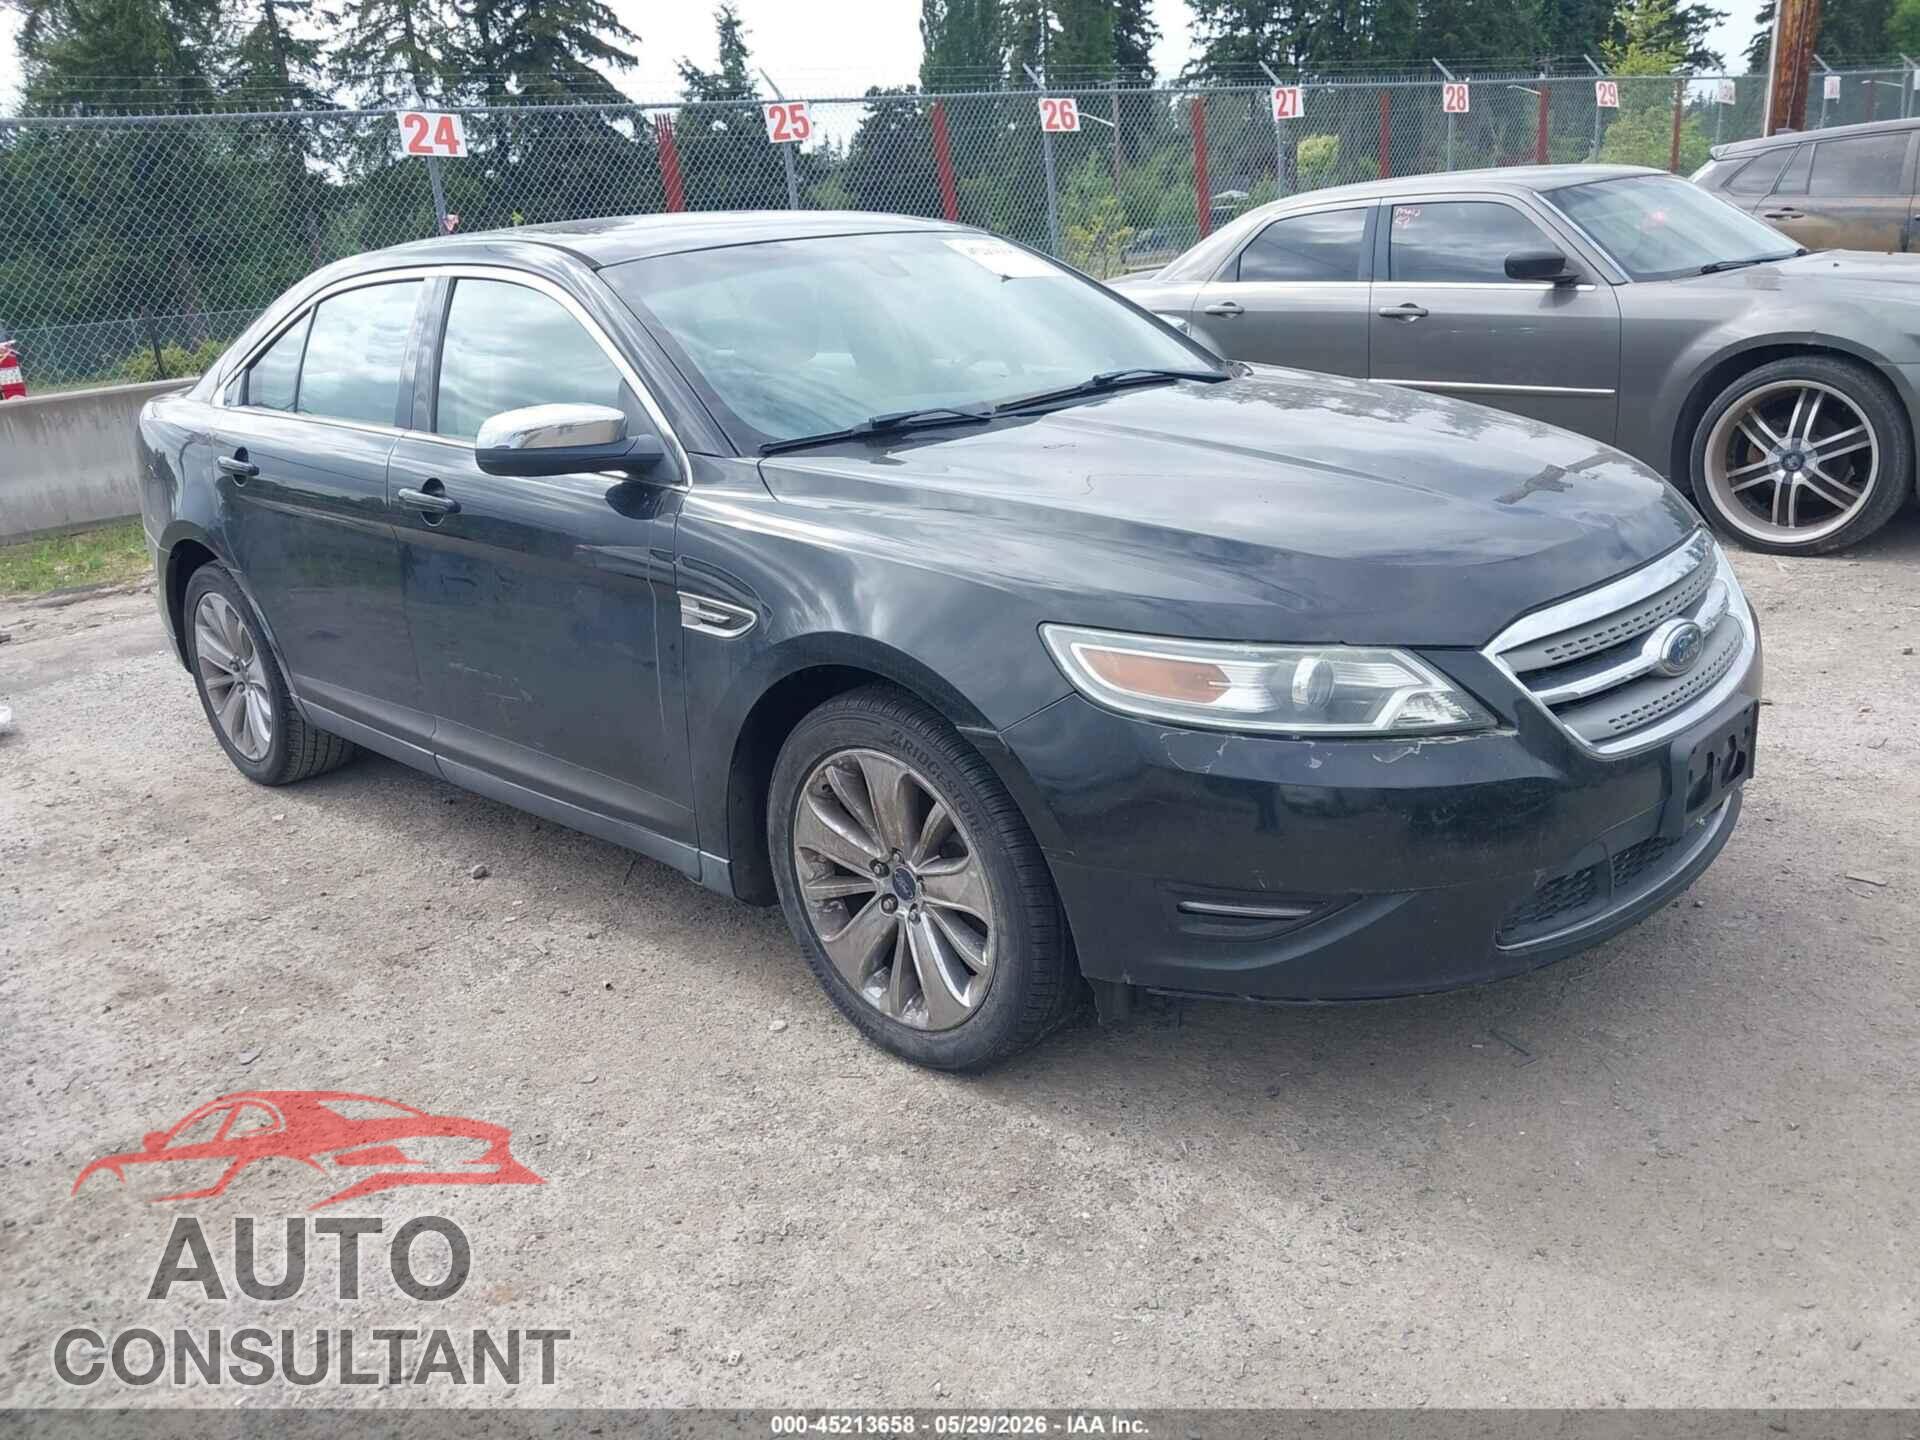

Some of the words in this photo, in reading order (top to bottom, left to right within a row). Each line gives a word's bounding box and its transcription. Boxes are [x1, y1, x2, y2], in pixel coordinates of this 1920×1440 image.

[1276, 90, 1298, 117] 27
[1446, 85, 1467, 111] 28
[1598, 83, 1617, 106] 29
[769, 104, 810, 141] 25
[1042, 100, 1076, 130] 26
[404, 114, 460, 154] 24
